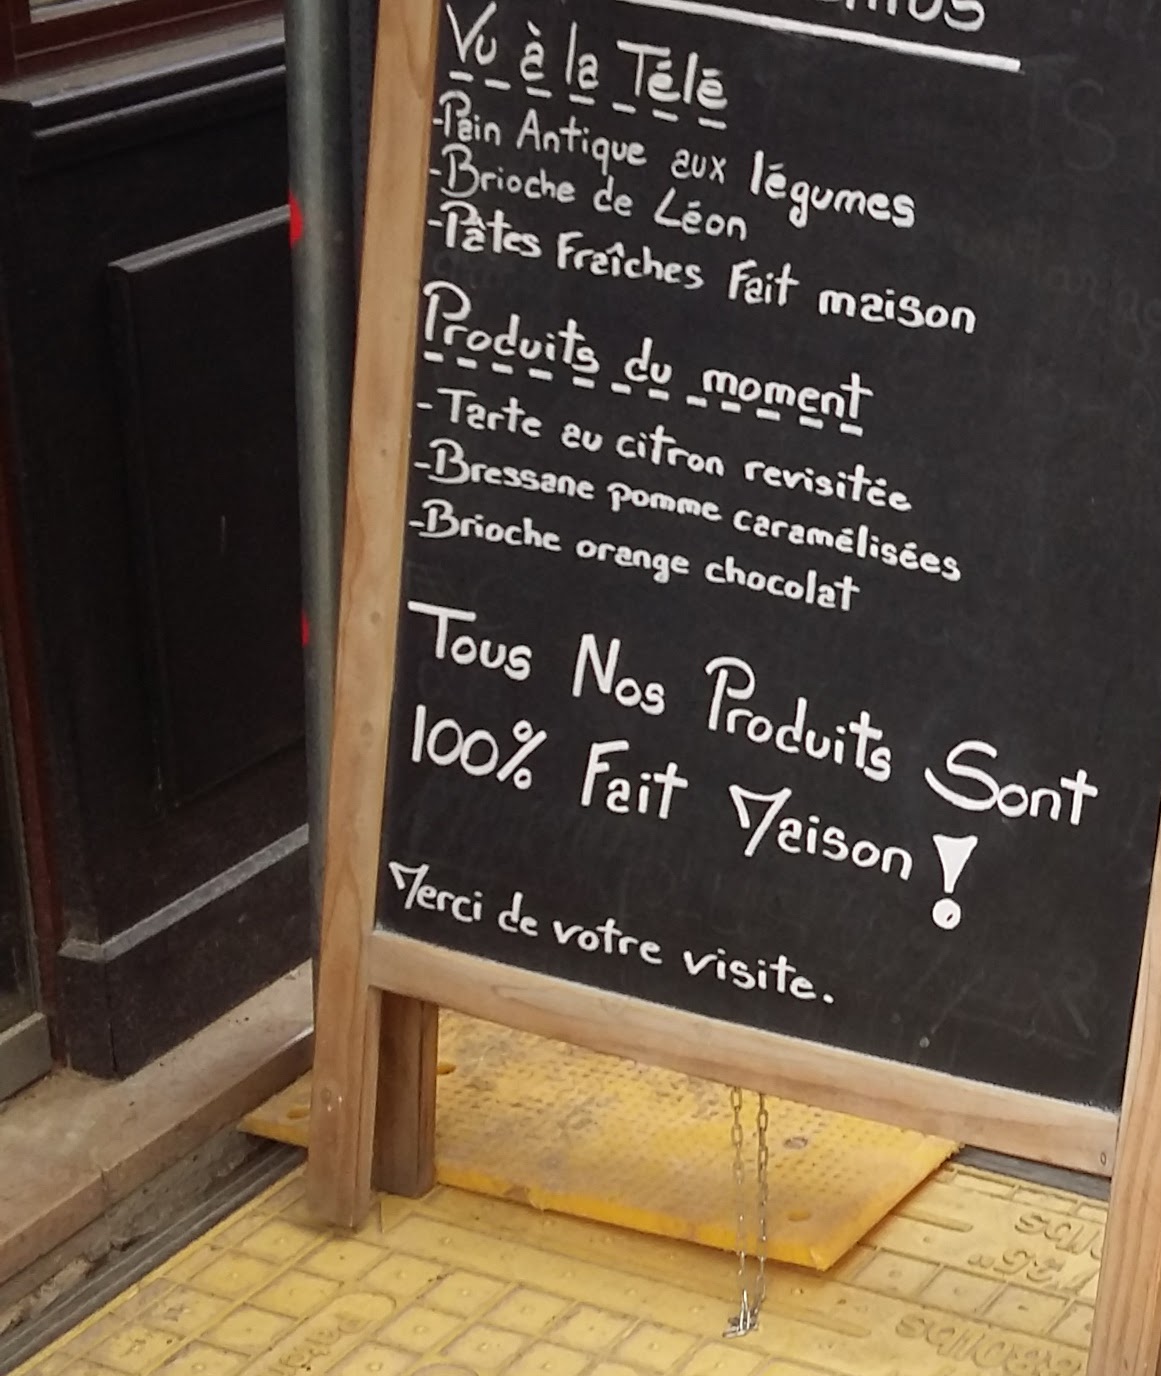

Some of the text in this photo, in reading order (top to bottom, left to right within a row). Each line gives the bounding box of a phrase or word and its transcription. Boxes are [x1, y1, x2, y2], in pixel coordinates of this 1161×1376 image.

[446, 1, 728, 111] Vu à la Télé
[516, 108, 648, 176] Antique
[670, 148, 727, 185] aux
[750, 150, 917, 228] légumes
[593, 176, 634, 218] de
[653, 187, 748, 242] Léon
[556, 231, 705, 291] Fraîches
[728, 259, 800, 308] Fait
[818, 288, 977, 334] maison
[422, 280, 874, 420] Produits du moment
[561, 423, 603, 452] au
[615, 424, 726, 478] citron
[743, 463, 912, 512] revisitée
[575, 537, 691, 585] orange
[704, 555, 861, 613] chocolat
[605, 480, 723, 523] pomme
[732, 506, 962, 583] caramélisées
[406, 598, 1100, 826] Tous Nos Produits Sont
[409, 702, 548, 792] 100%
[579, 739, 690, 821] Fait
[727, 782, 914, 881] Maison
[388, 860, 484, 925] Merci
[496, 890, 540, 941] de
[552, 917, 665, 967] votre
